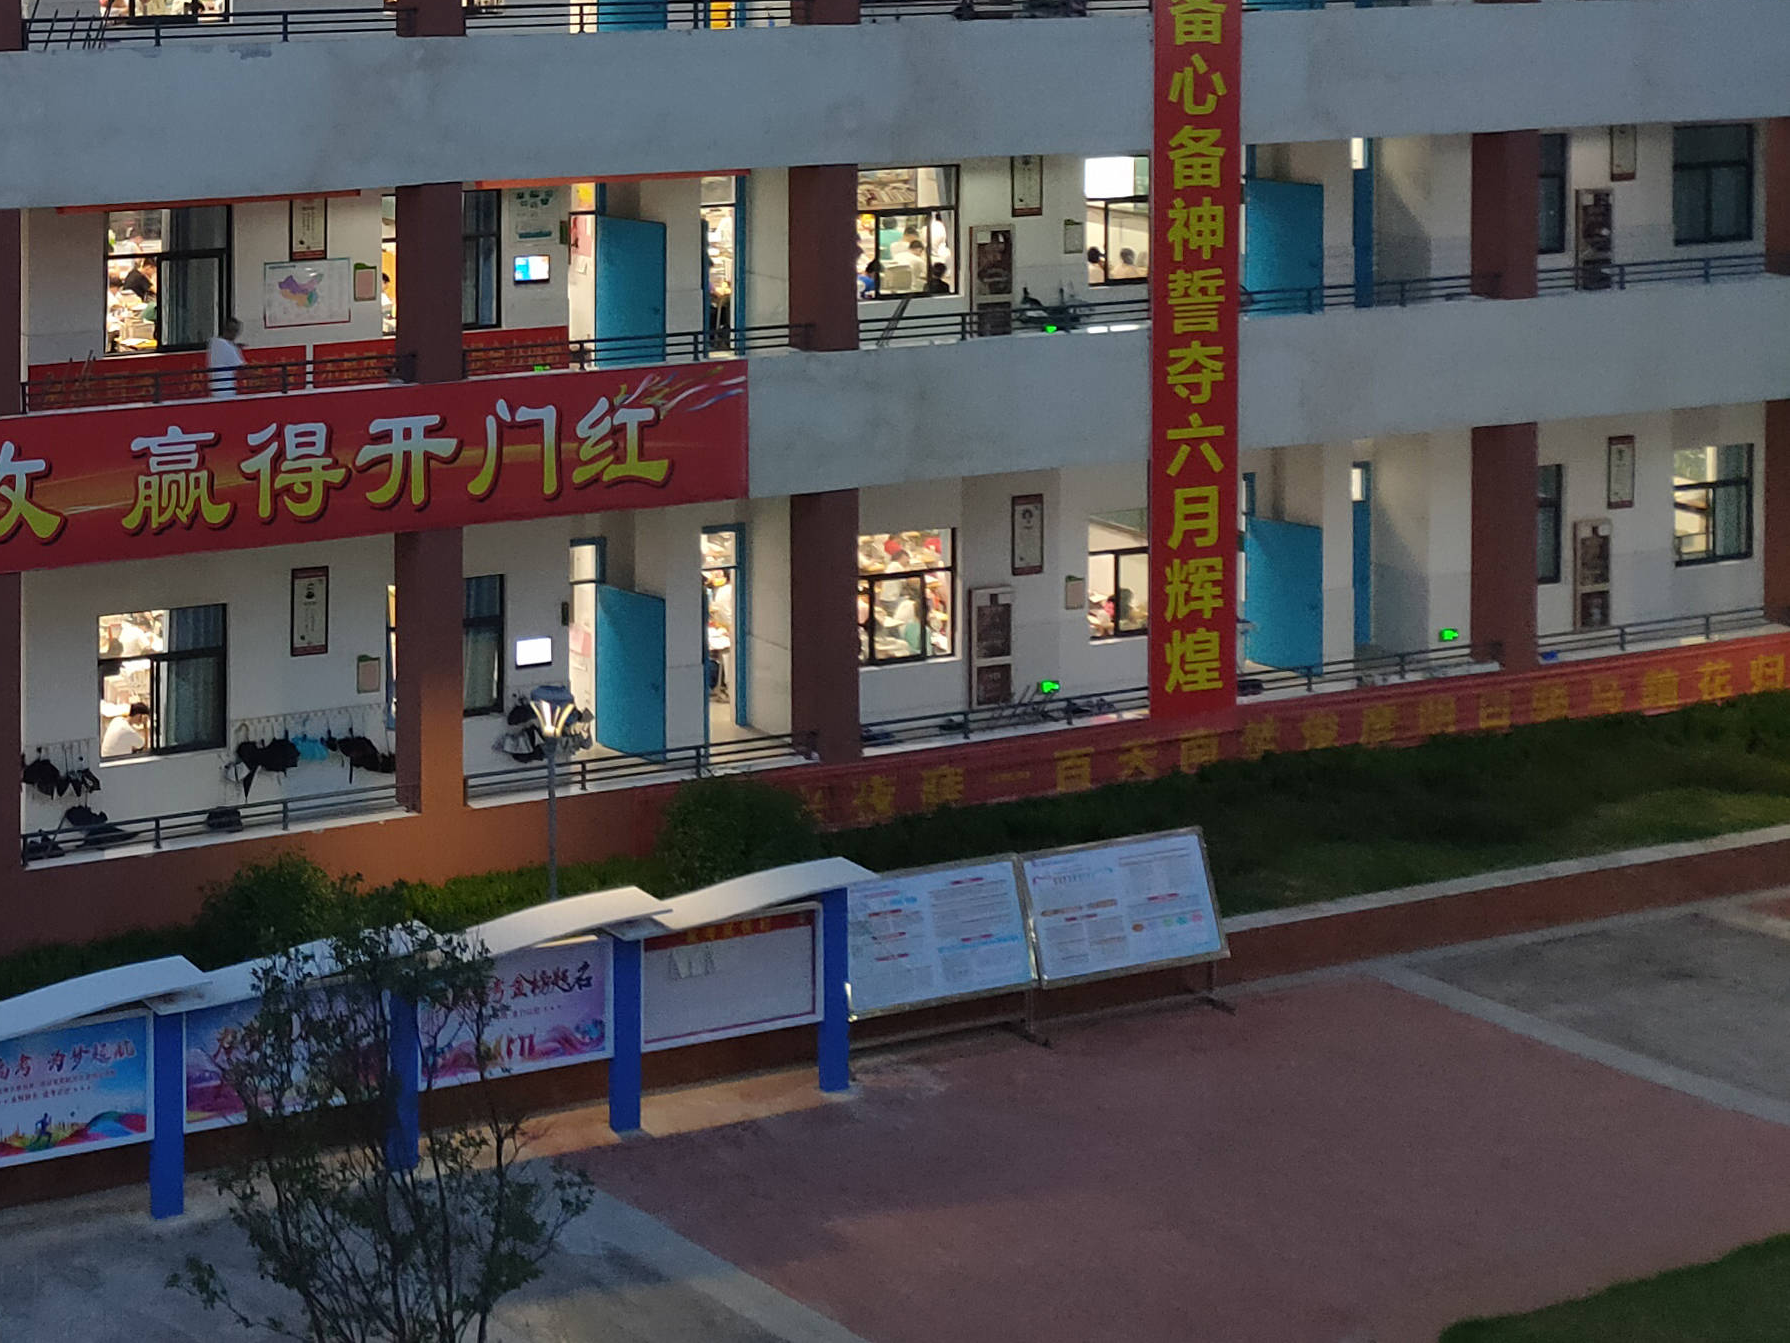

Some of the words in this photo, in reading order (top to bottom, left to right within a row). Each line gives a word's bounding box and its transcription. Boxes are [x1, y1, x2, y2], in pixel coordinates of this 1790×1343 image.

[121, 396, 672, 530] 赢得开门红
